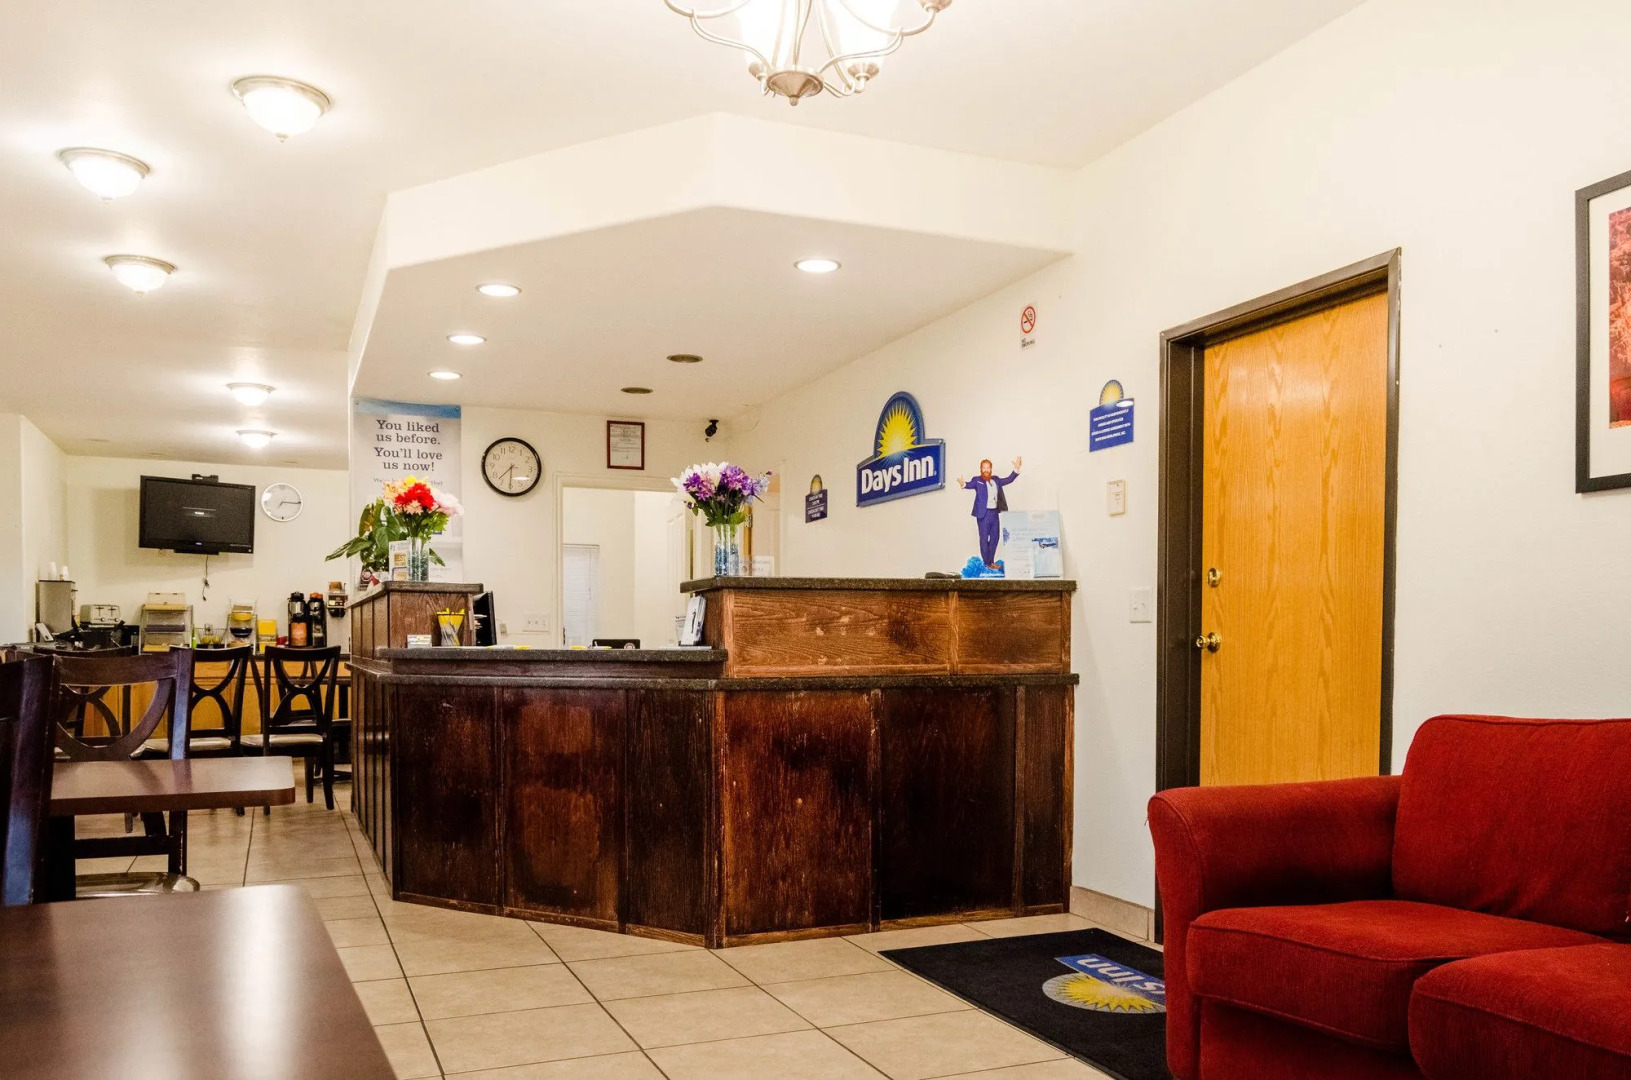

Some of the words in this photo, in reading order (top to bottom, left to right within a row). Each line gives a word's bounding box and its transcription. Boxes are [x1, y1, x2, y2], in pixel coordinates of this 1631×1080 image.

[376, 419, 402, 431] You
[407, 422, 440, 433] liked
[376, 434, 392, 442] us
[396, 433, 441, 445] before.
[374, 446, 412, 458] You'll
[416, 449, 443, 460] love
[383, 461, 399, 470] us
[403, 462, 435, 472] now!
[861, 464, 901, 495] Days
[903, 455, 934, 484] Inn
[1077, 957, 1145, 983] Inn
